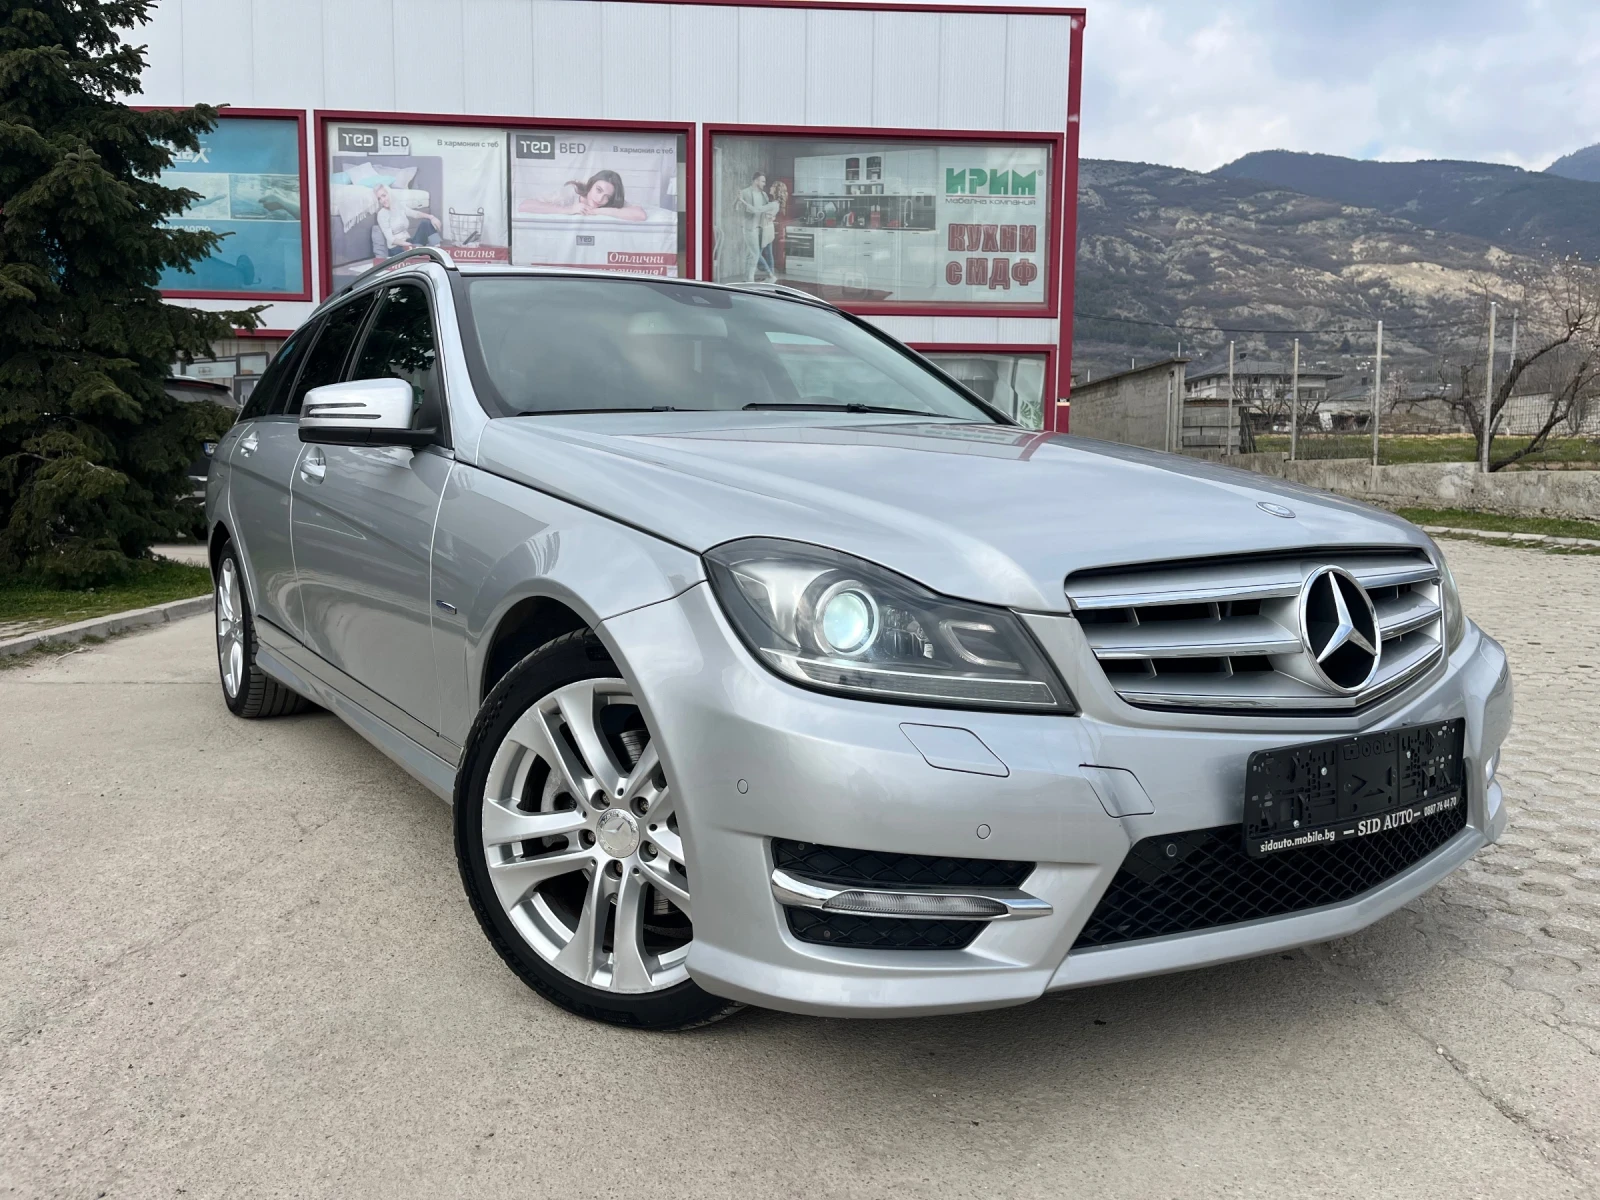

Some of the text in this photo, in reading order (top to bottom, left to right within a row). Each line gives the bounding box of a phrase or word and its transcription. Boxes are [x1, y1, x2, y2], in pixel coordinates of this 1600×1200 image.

[383, 135, 409, 147] BED
[560, 142, 586, 154] BED
[619, 147, 655, 155] хармония
[948, 223, 1037, 253] КУХНИ
[453, 248, 496, 259] спалня
[609, 252, 664, 264] Отлични
[1260, 829, 1336, 853] sidauto.mobile.bg
[1358, 818, 1381, 837] SID
